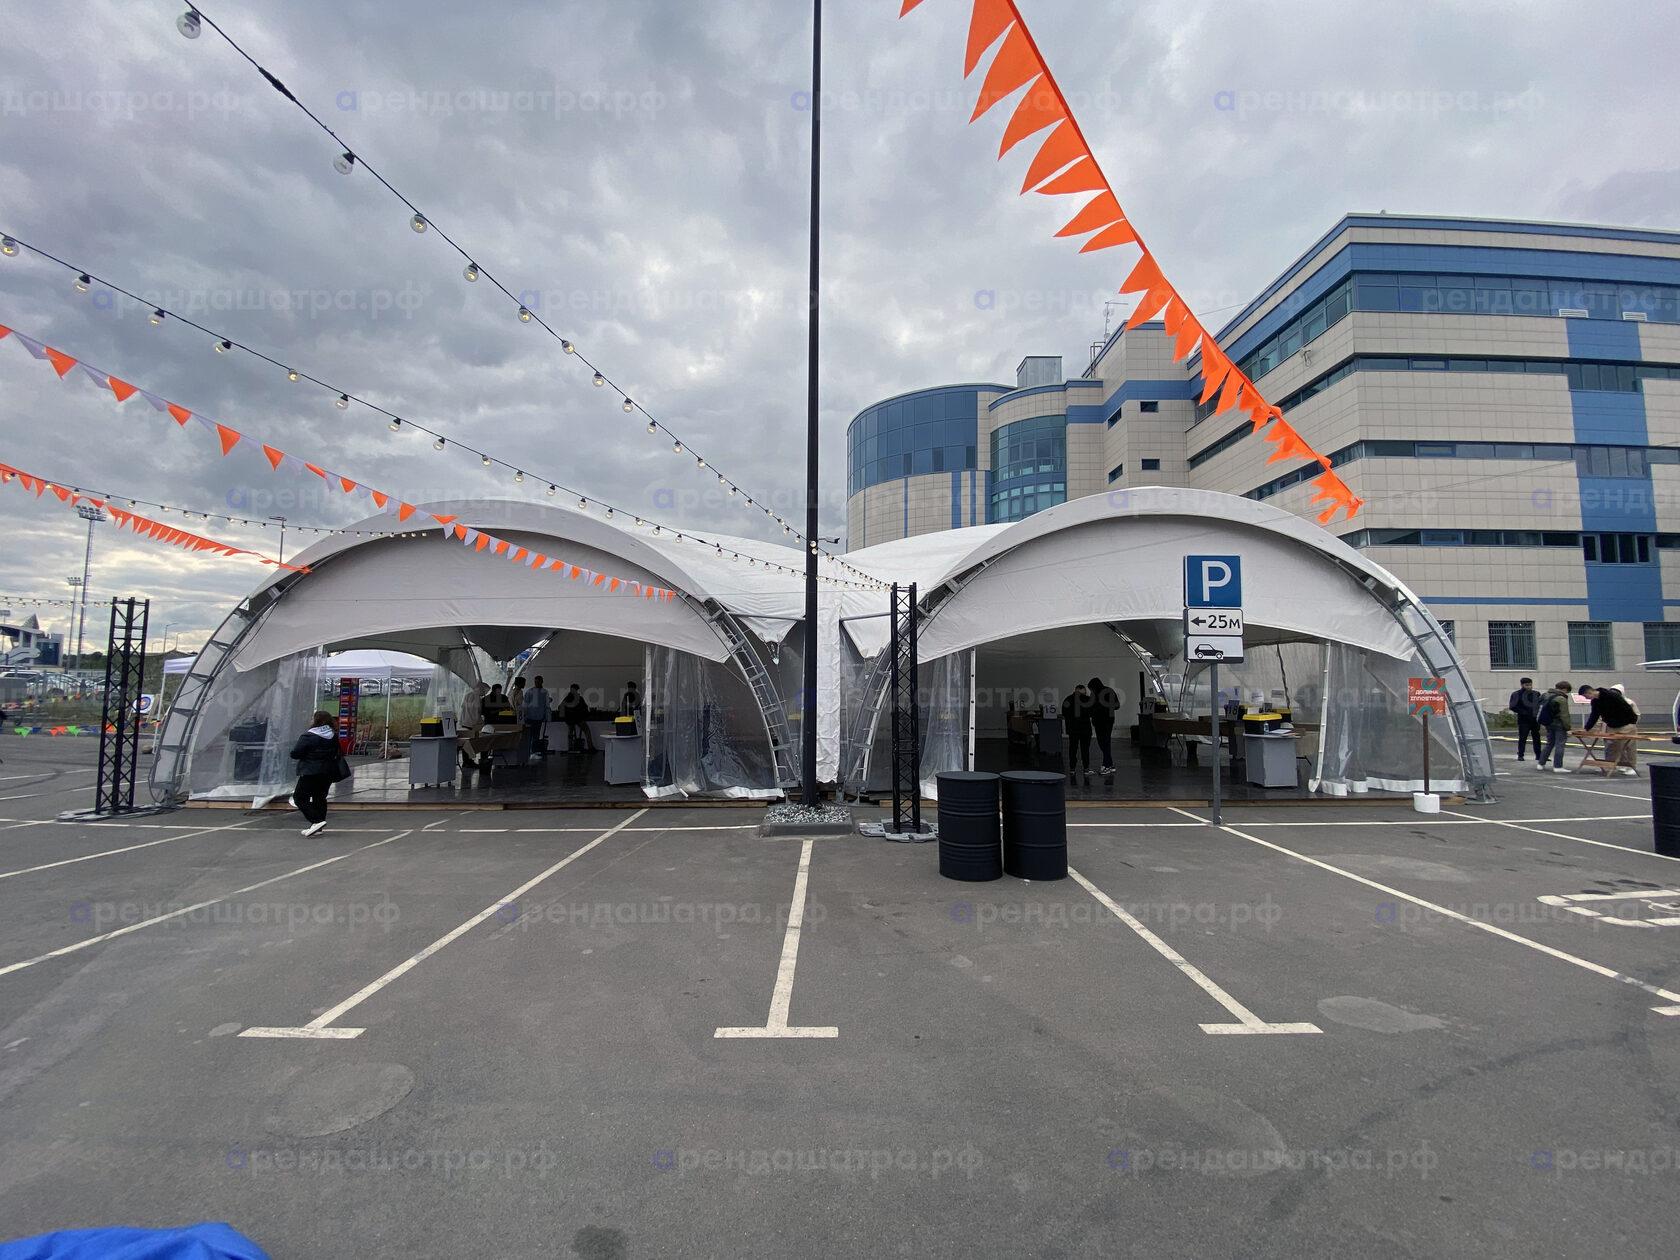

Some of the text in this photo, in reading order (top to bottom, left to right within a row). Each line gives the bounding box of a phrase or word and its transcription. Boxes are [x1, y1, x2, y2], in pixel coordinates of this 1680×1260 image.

[1202, 561, 1231, 601] P
[1043, 704, 1057, 714] 15
[445, 717, 451, 730] 7
